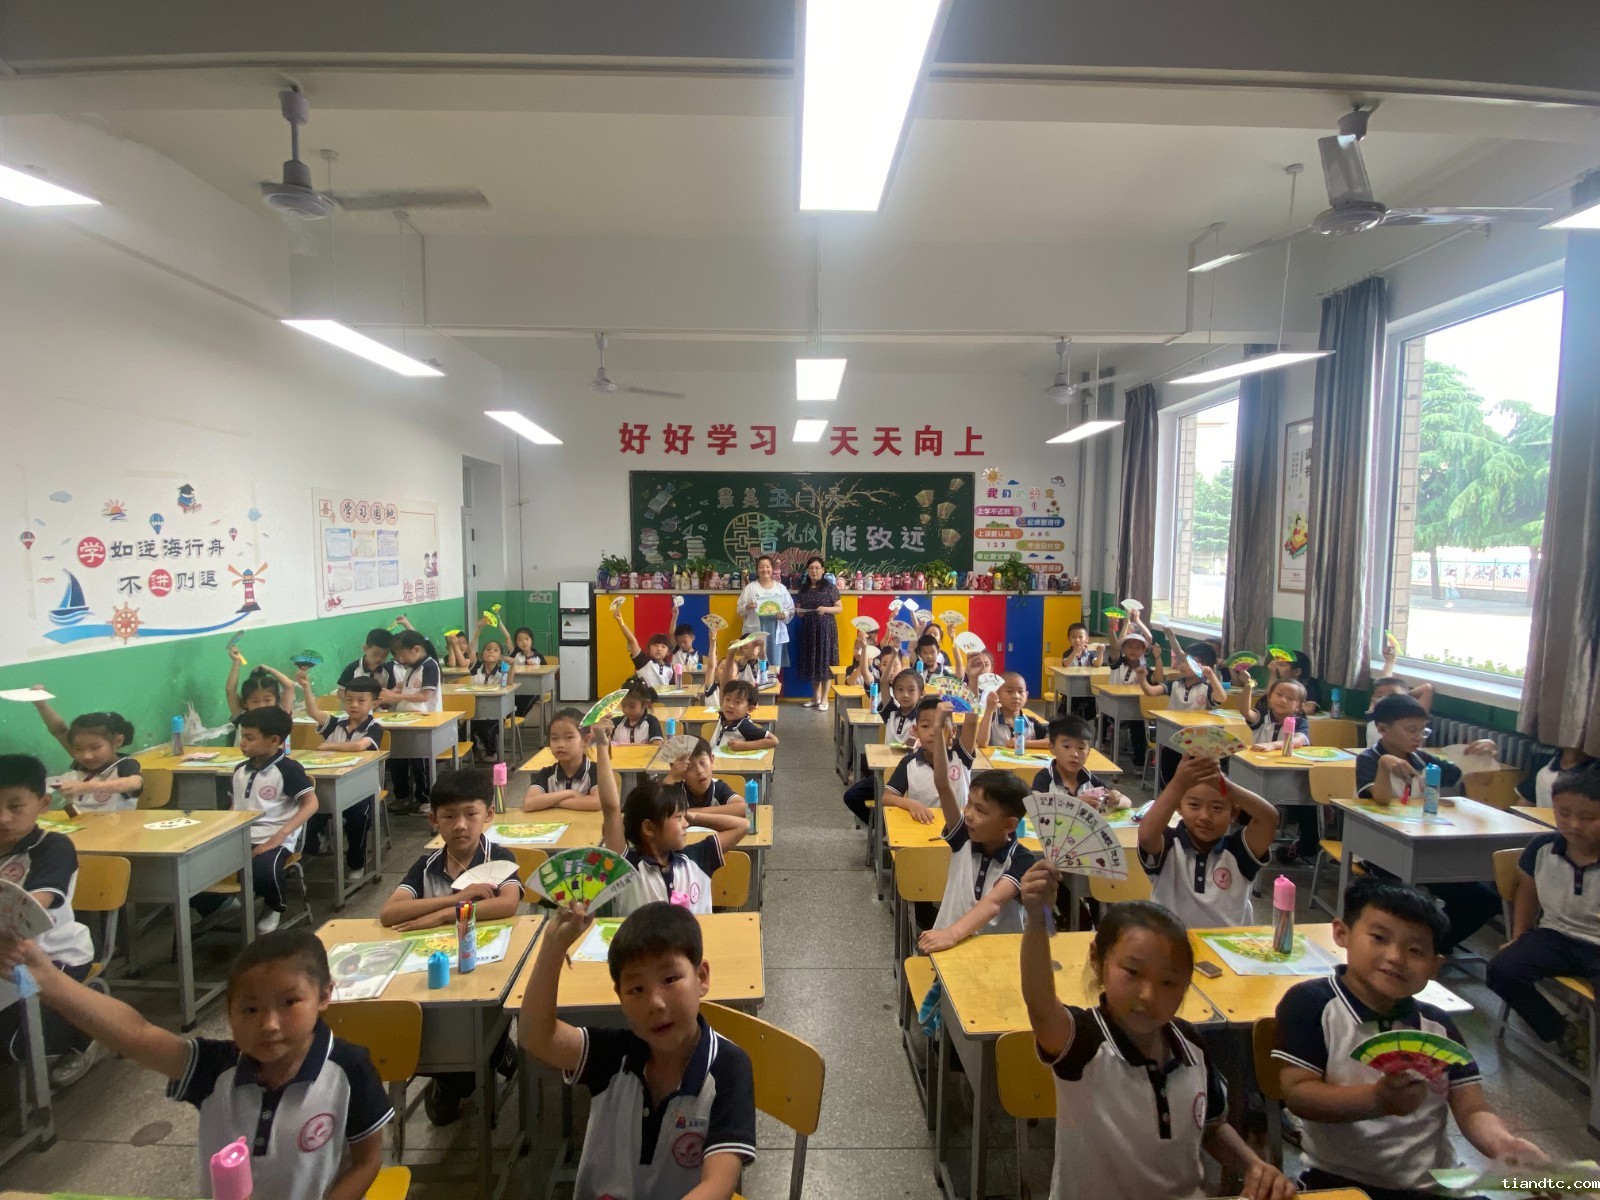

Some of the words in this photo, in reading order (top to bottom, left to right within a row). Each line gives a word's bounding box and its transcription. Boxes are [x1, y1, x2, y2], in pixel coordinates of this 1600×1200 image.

[619, 422, 777, 454] 好好学习
[829, 424, 985, 457] 天天向上
[716, 486, 846, 510] 最美五月天
[987, 487, 1055, 499] 我们的约定
[343, 501, 396, 520] 学习园地
[977, 507, 1010, 515] 上学不迟到
[1027, 518, 1061, 526] 纪律要遵守
[830, 524, 926, 553] 能致远
[977, 530, 1011, 538] 上课要认真
[1027, 542, 1061, 550] 作业及时交
[976, 552, 1011, 561] 举止要文明
[120, 570, 219, 594] 不进则退
